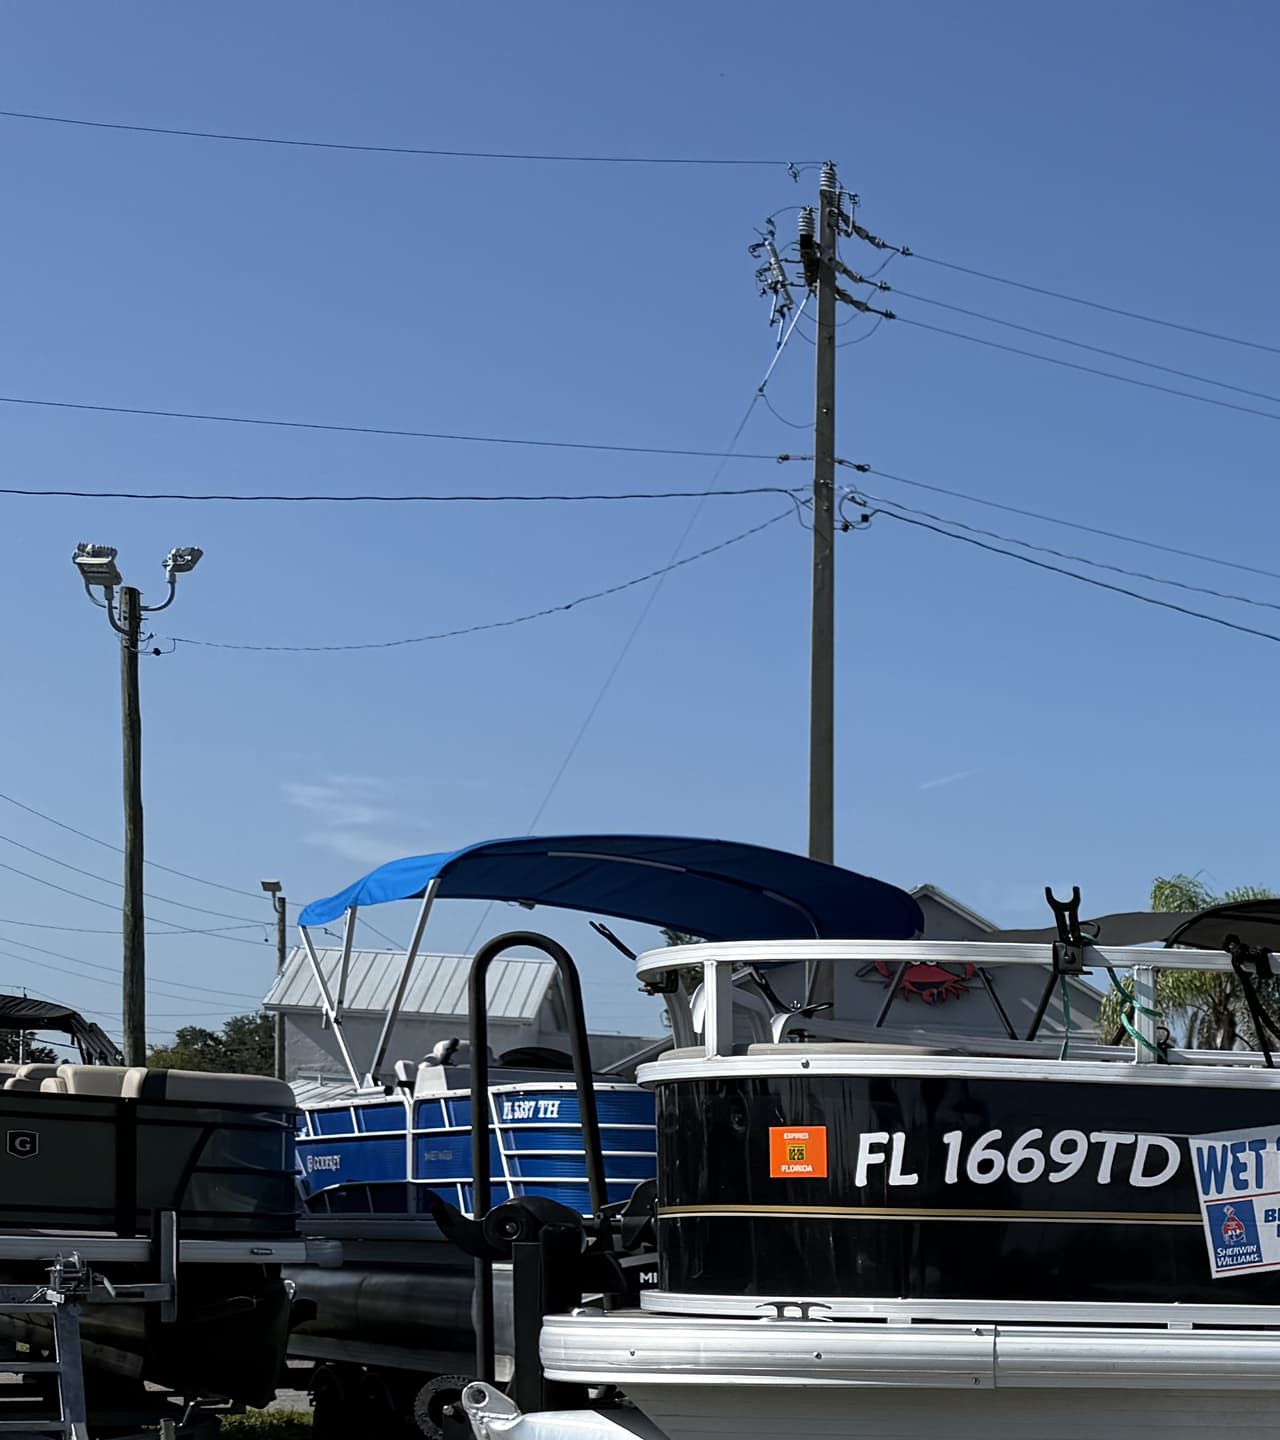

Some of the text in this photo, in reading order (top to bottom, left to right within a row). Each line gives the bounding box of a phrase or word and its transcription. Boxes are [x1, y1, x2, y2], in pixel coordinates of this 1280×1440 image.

[538, 1100, 561, 1118] TH
[15, 1136, 31, 1151] G
[855, 1128, 1181, 1187] FL 1669TD
[781, 1164, 813, 1172] FLORIDA
[1196, 1138, 1267, 1196] WET
[1216, 1244, 1257, 1257] SHERWIN
[1216, 1254, 1260, 1267] WILLIAMS
